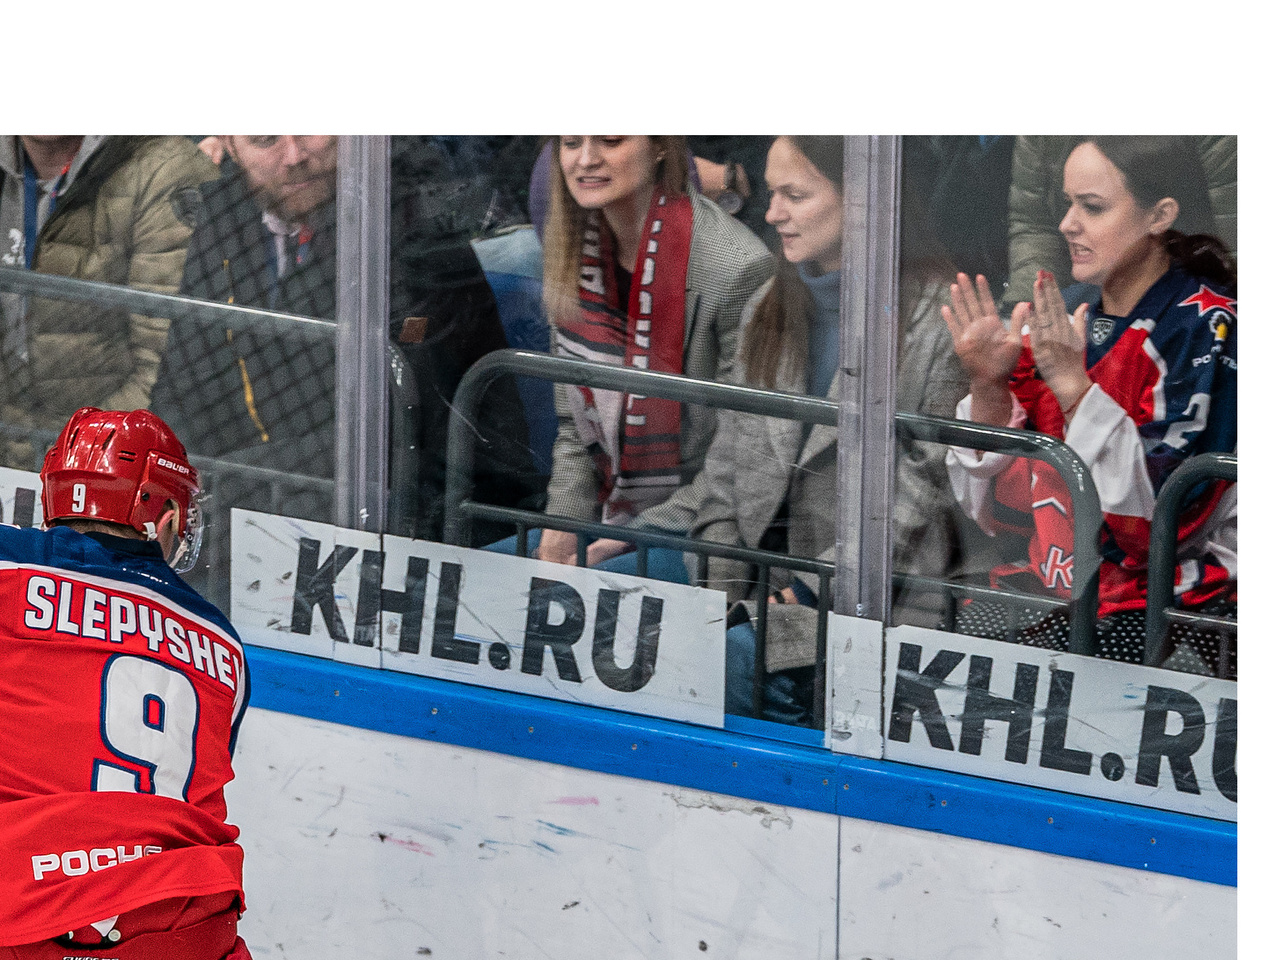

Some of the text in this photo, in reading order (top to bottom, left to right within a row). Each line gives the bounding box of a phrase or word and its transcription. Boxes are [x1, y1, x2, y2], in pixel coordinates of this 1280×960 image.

[71, 483, 86, 513] 9
[291, 537, 664, 694] KHL.RU
[90, 652, 200, 803] 9
